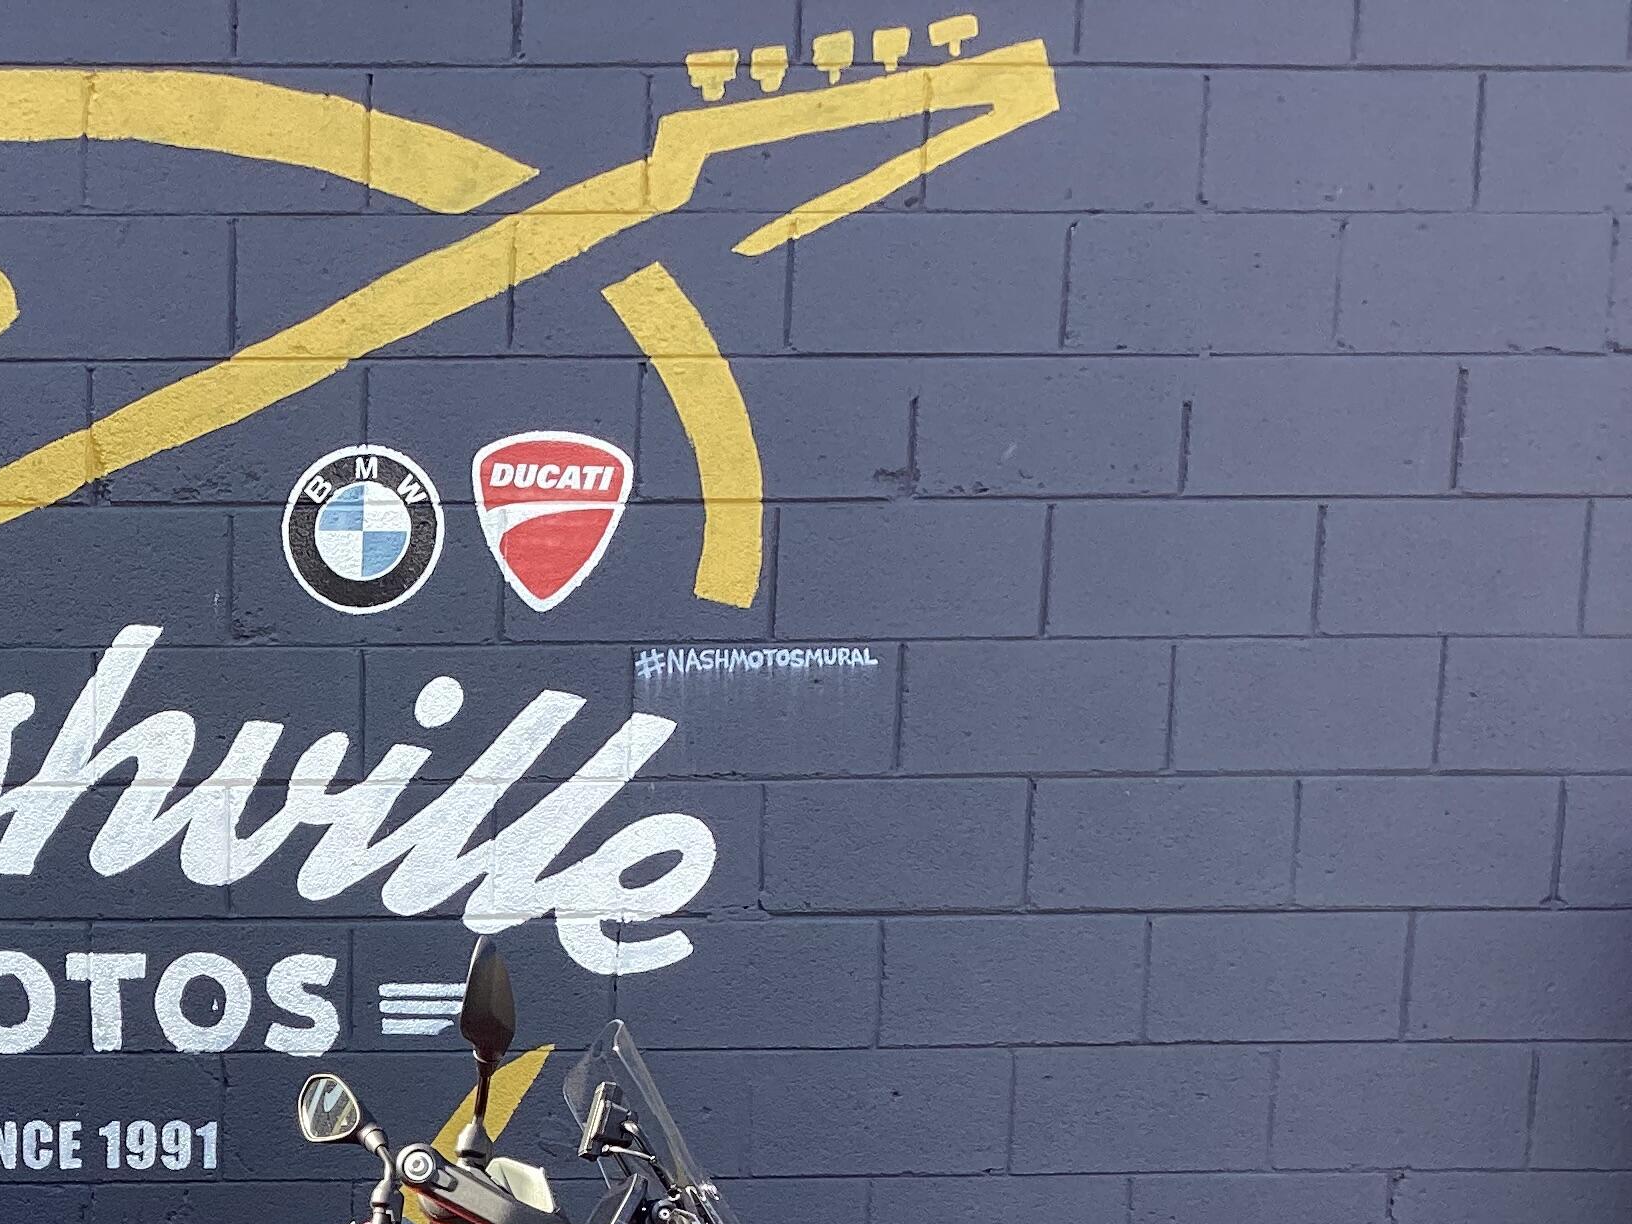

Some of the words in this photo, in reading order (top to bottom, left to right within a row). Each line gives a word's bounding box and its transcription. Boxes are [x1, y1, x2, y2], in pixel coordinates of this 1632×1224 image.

[305, 457, 428, 505] BMW
[489, 462, 615, 491] DUCATI
[634, 646, 878, 679] #NASHMOTOSMURAL
[99, 1119, 219, 1171] 1991
